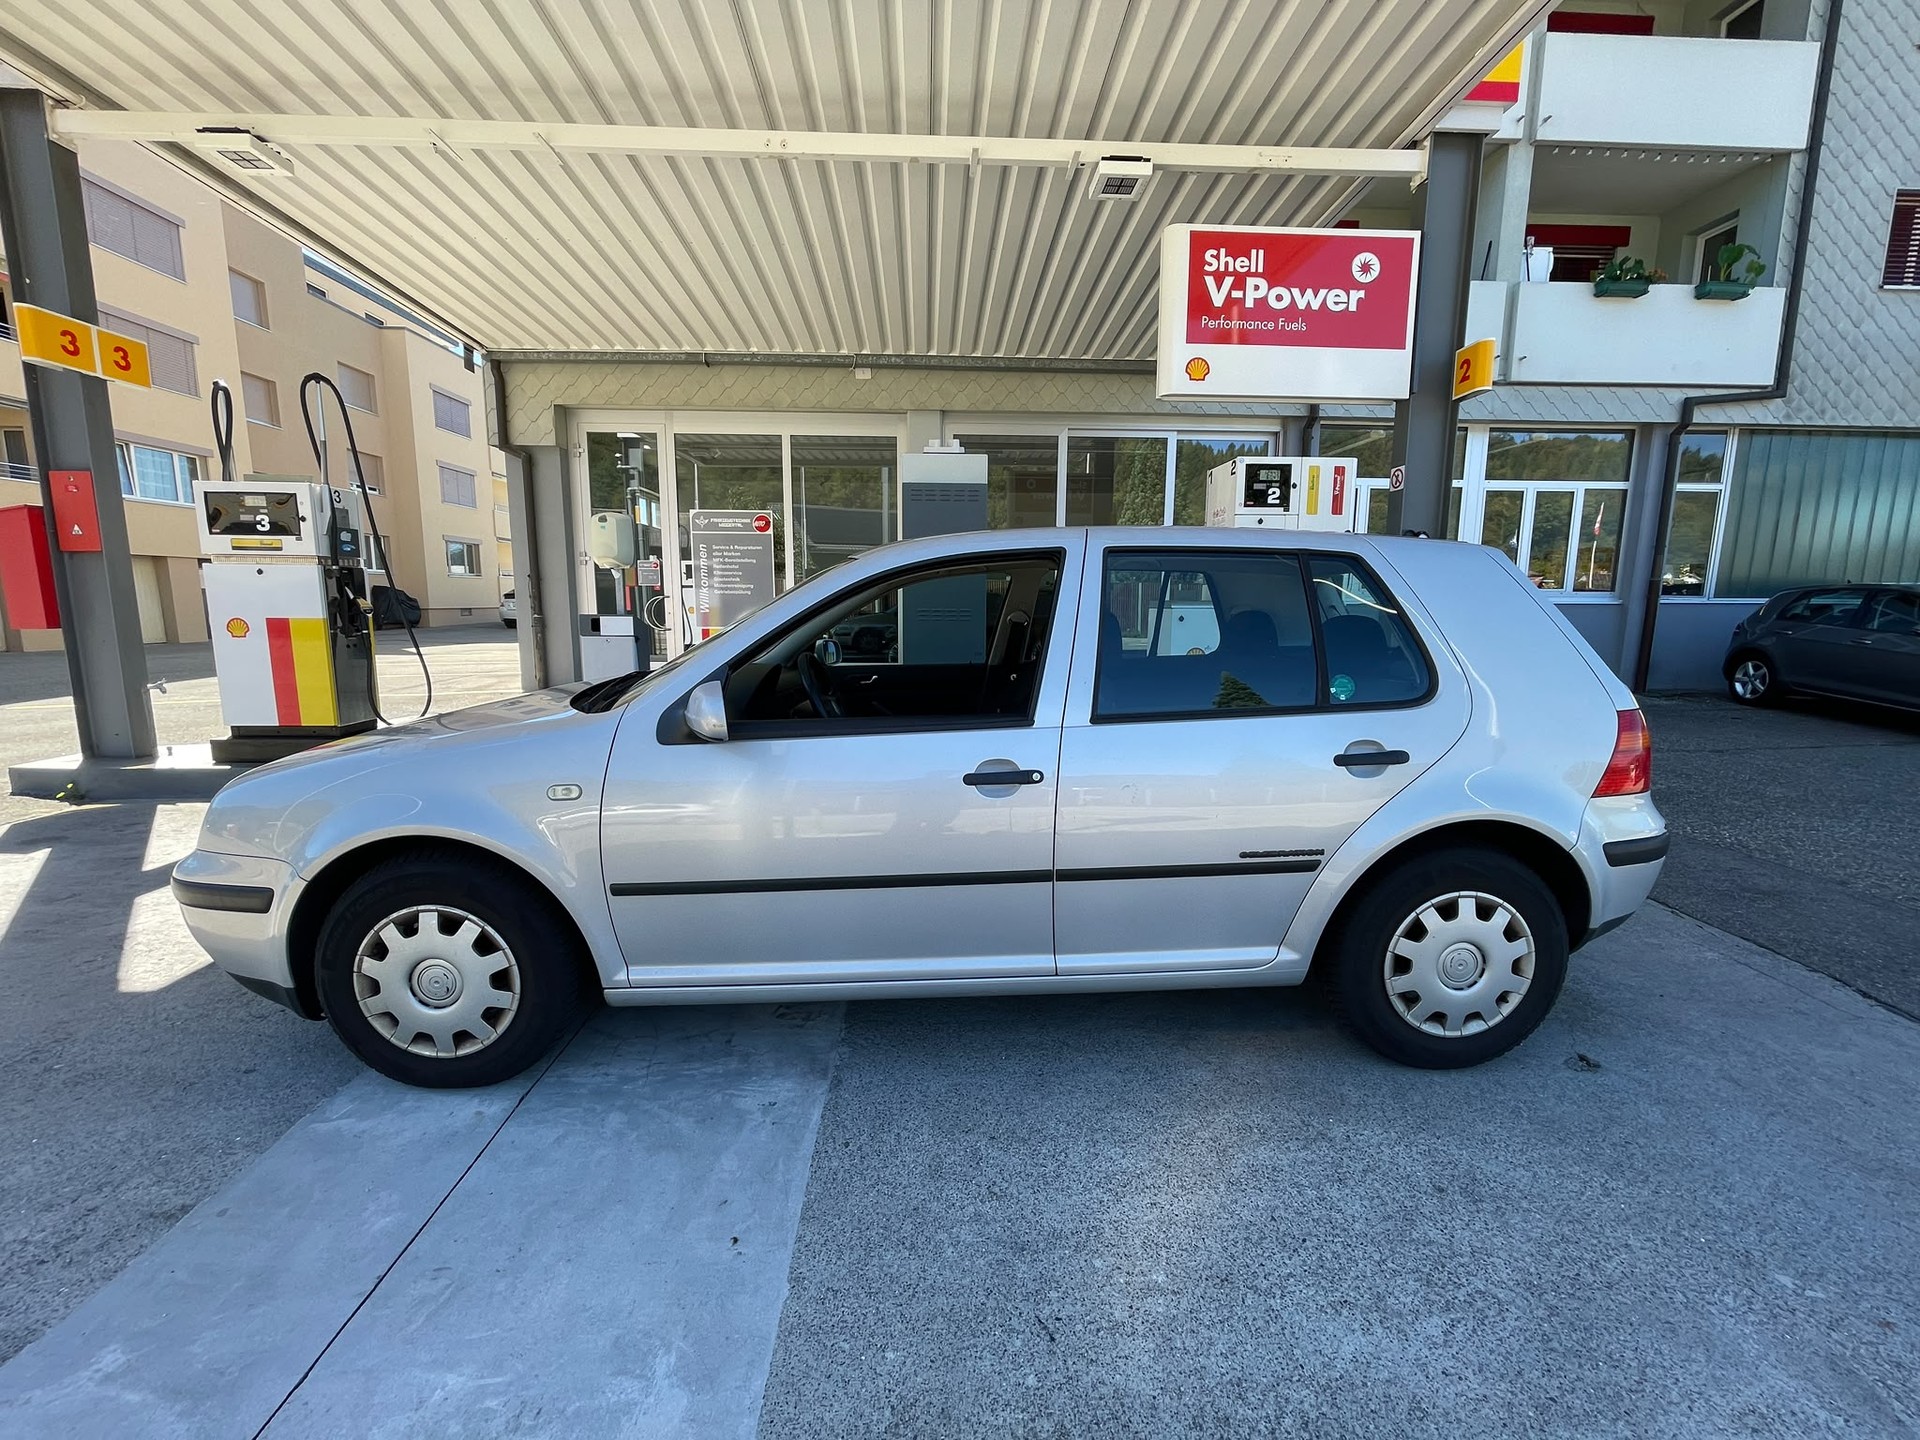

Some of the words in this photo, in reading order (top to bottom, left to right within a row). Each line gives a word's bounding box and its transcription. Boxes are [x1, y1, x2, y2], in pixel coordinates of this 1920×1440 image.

[1203, 248, 1264, 273] Shell
[1203, 275, 1365, 312] V-Power
[1201, 315, 1275, 330] Performance
[1278, 317, 1307, 331] Fuels
[59, 329, 80, 357] 3
[113, 346, 132, 372] 3
[1458, 358, 1471, 384] 2
[1208, 470, 1213, 485] 1
[1230, 460, 1237, 476] 2
[333, 490, 342, 504] 3
[1267, 487, 1281, 504] 2
[255, 514, 271, 532] 3
[699, 544, 710, 613] Willkommen
